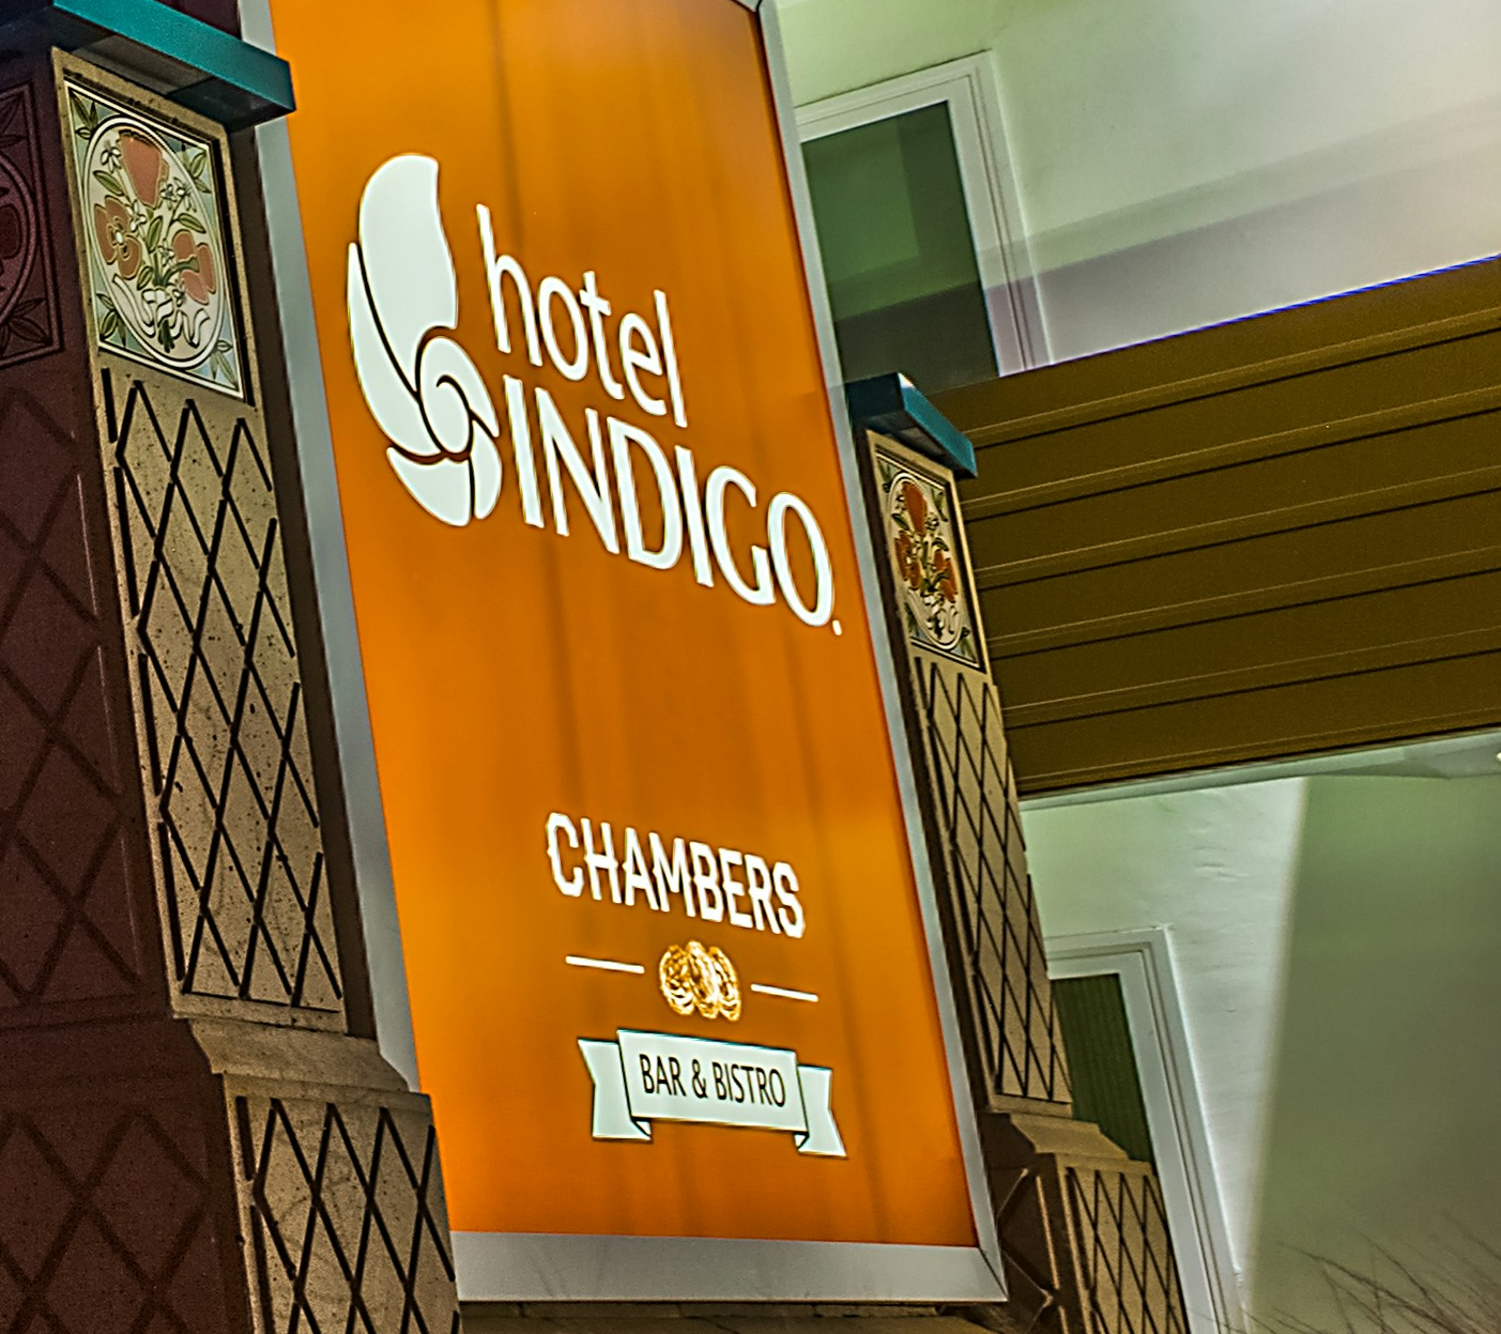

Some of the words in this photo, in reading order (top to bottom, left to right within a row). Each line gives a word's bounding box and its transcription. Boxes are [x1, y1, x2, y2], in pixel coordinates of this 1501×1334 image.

[476, 203, 688, 428] hotel
[503, 373, 835, 628] INDIGO
[546, 812, 806, 939] CHAMBERS
[639, 1053, 686, 1097] BAR
[691, 1058, 708, 1099] &
[712, 1061, 786, 1108] BISTRO
